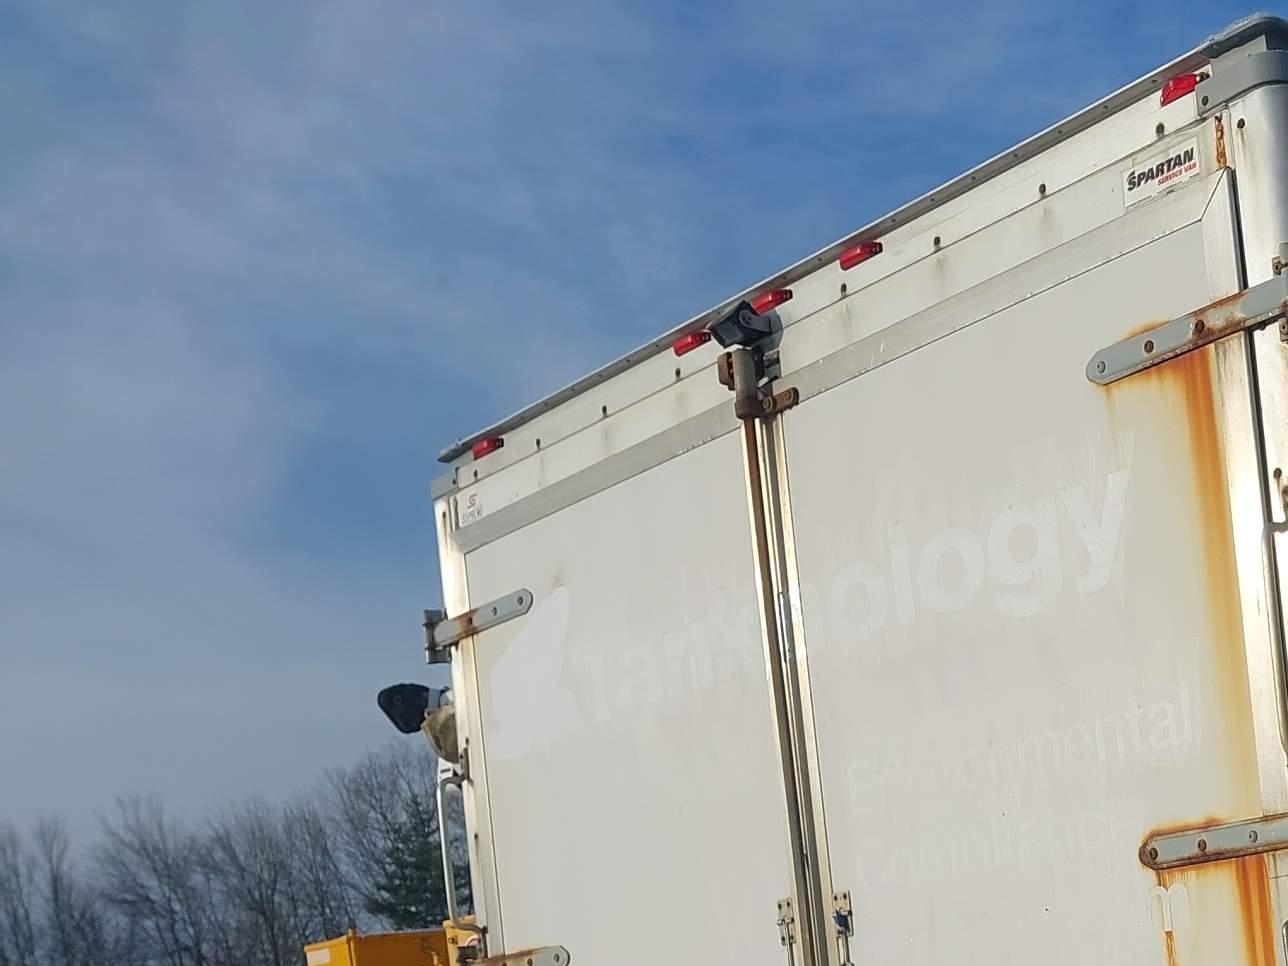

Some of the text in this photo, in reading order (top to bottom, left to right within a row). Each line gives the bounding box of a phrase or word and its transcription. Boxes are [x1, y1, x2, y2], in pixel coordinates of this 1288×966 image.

[1126, 147, 1194, 192] SPARTAN
[1157, 162, 1197, 186] SERVICE VAN
